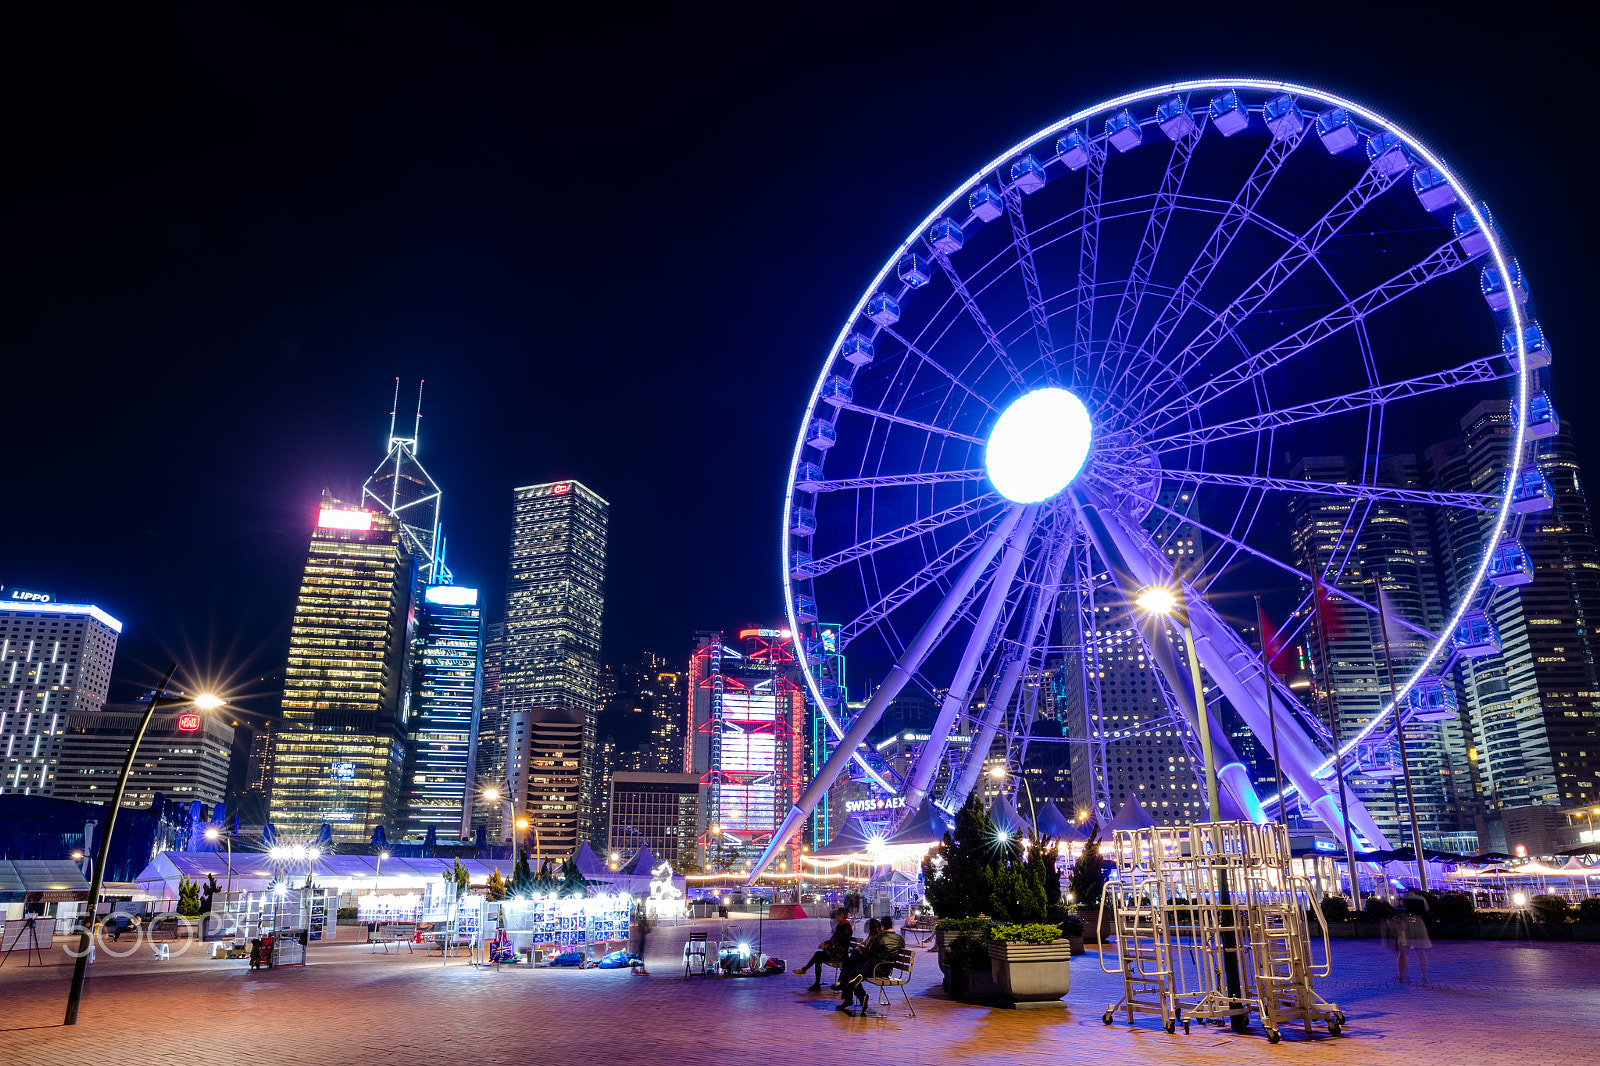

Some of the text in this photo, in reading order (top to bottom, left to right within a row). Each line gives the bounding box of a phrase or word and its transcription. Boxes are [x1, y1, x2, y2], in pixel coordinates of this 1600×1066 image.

[12, 590, 50, 602] LIPPO
[845, 797, 906, 812] SWISS AEX
